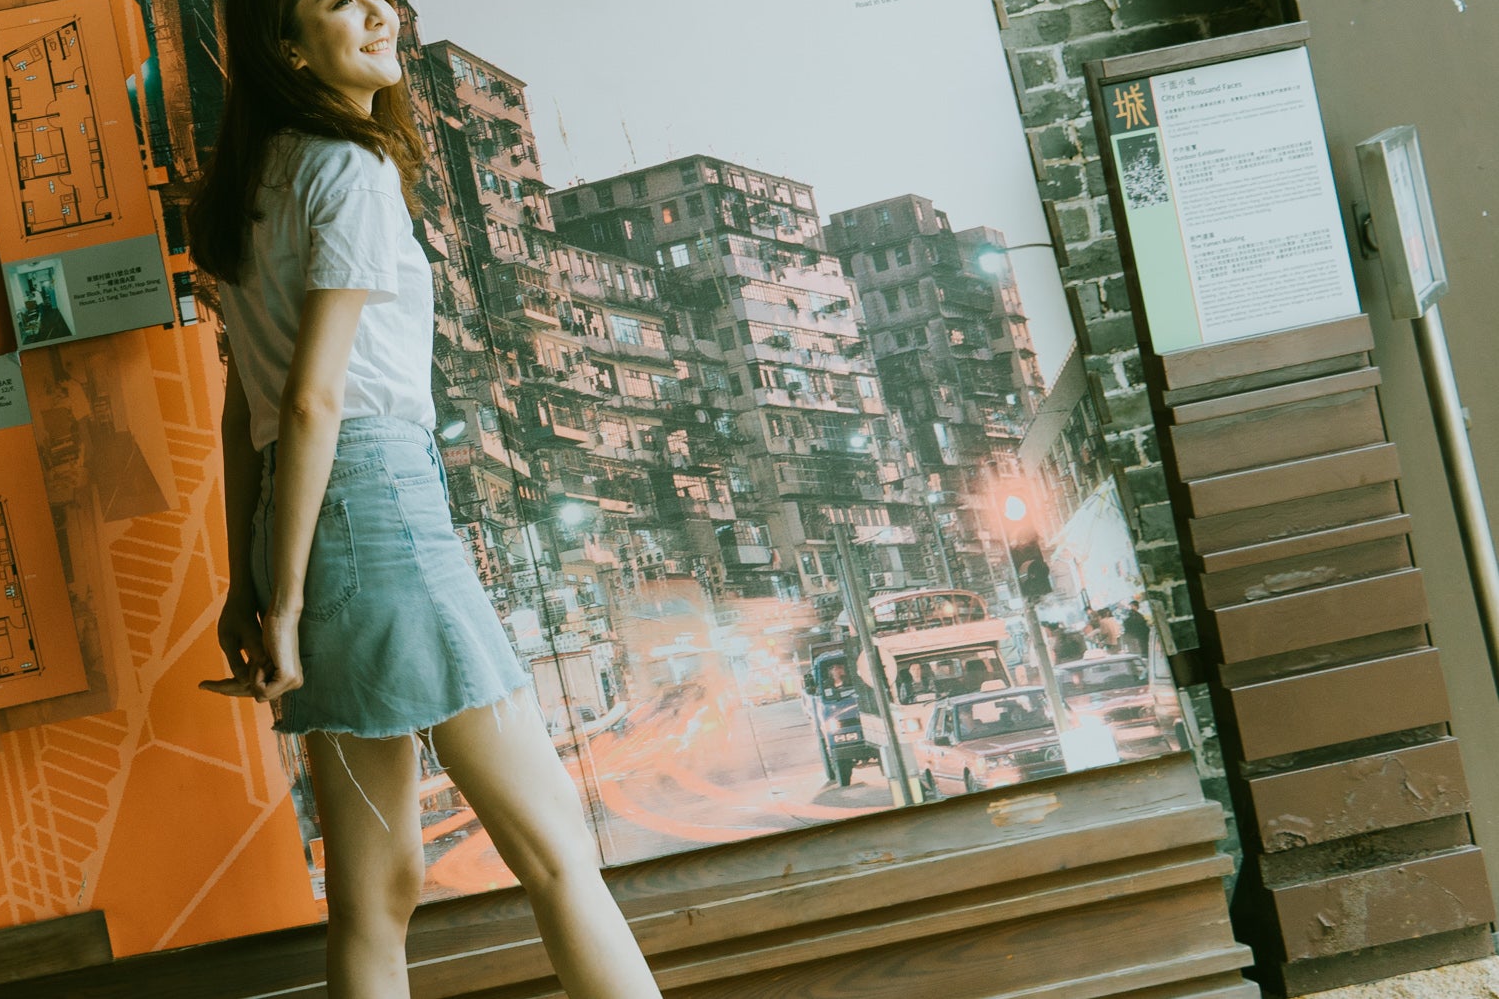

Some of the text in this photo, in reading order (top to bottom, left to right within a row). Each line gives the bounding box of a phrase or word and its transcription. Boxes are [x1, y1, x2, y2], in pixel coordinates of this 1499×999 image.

[1113, 82, 1150, 130] 城
[1160, 82, 1242, 102] City of Thousand Faces
